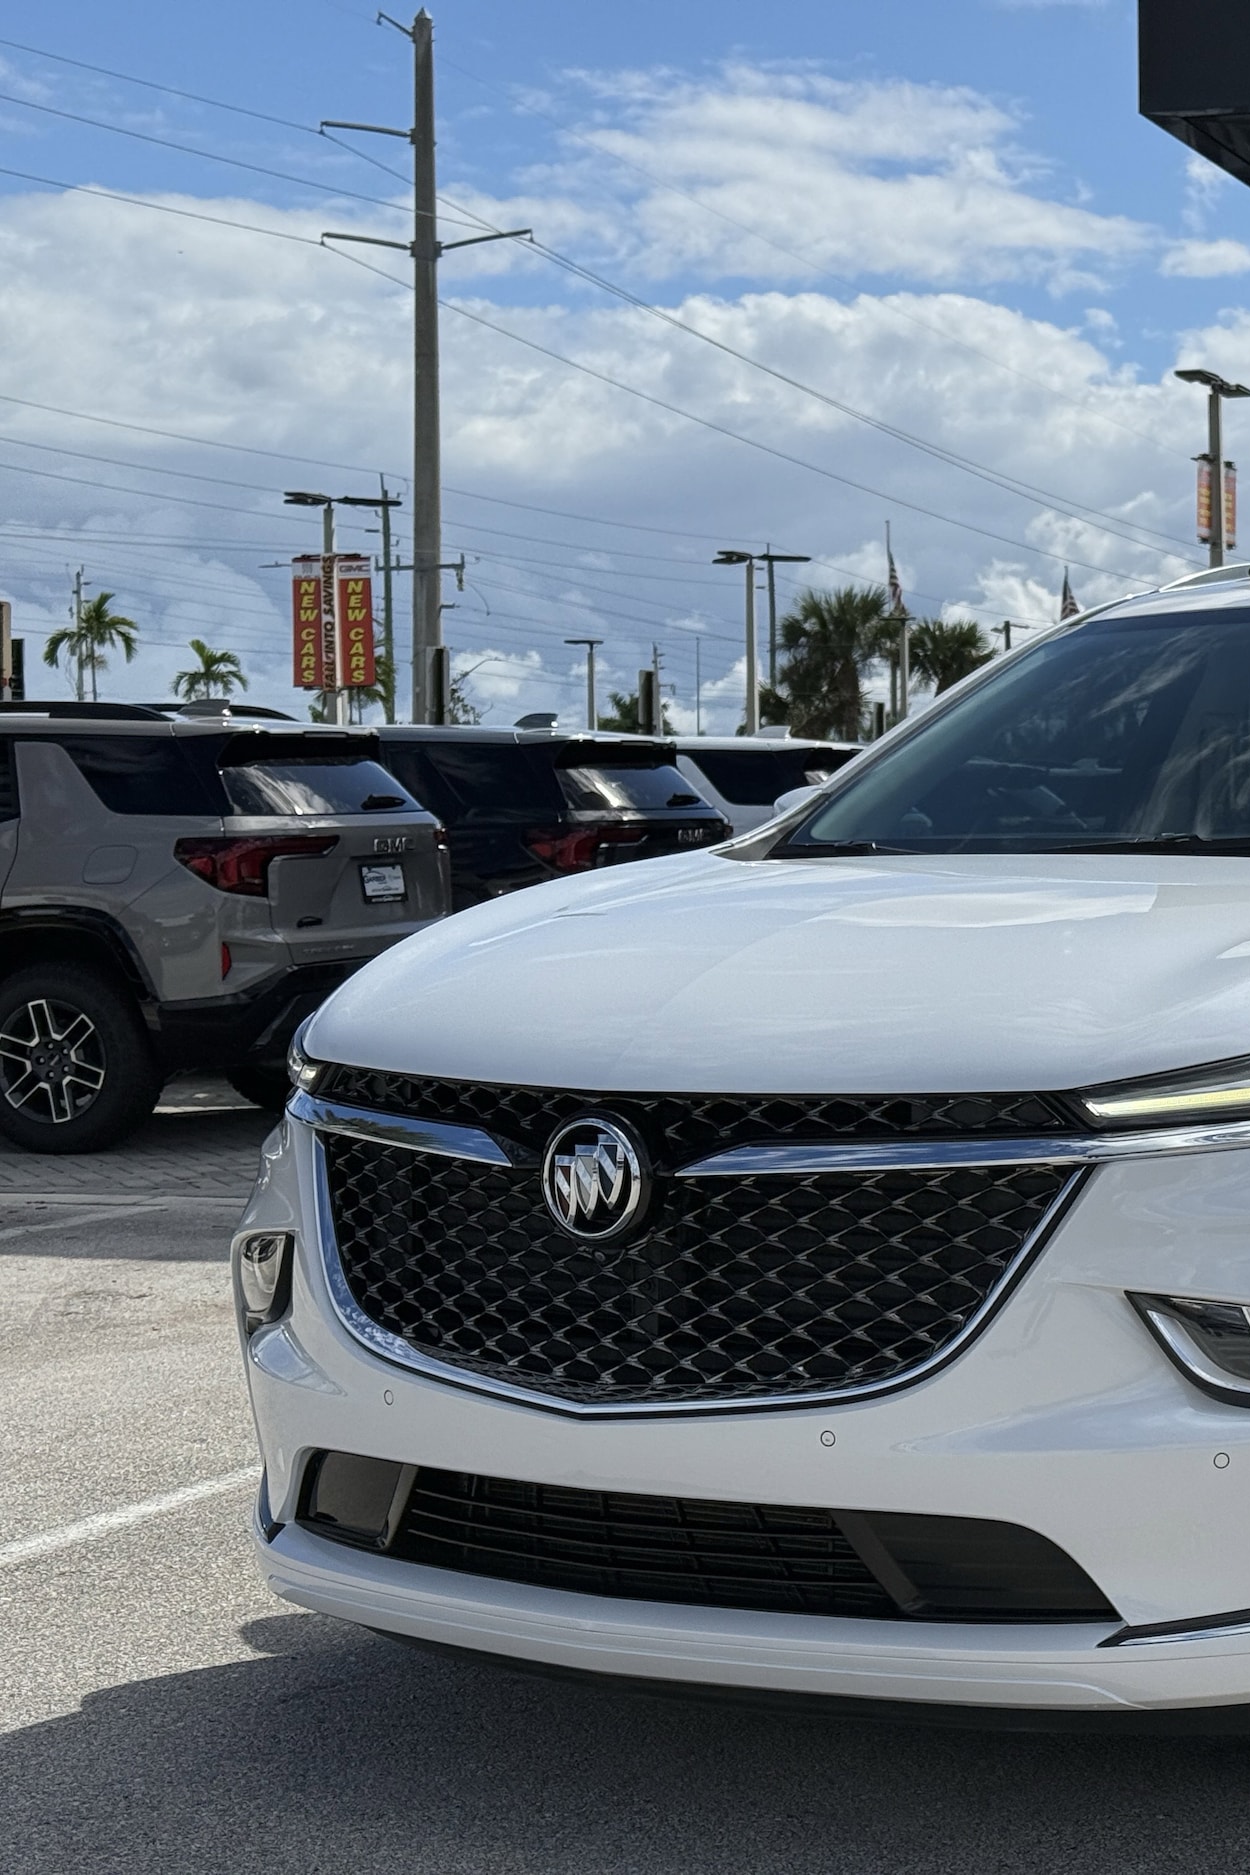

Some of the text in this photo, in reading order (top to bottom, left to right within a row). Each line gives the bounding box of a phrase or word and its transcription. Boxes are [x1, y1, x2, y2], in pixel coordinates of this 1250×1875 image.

[339, 564, 370, 573] GMC
[299, 581, 318, 621] NEW
[321, 555, 336, 689] FALL INTO SAVINGS
[300, 628, 317, 683] CARS
[346, 580, 367, 683] NEW CARS
